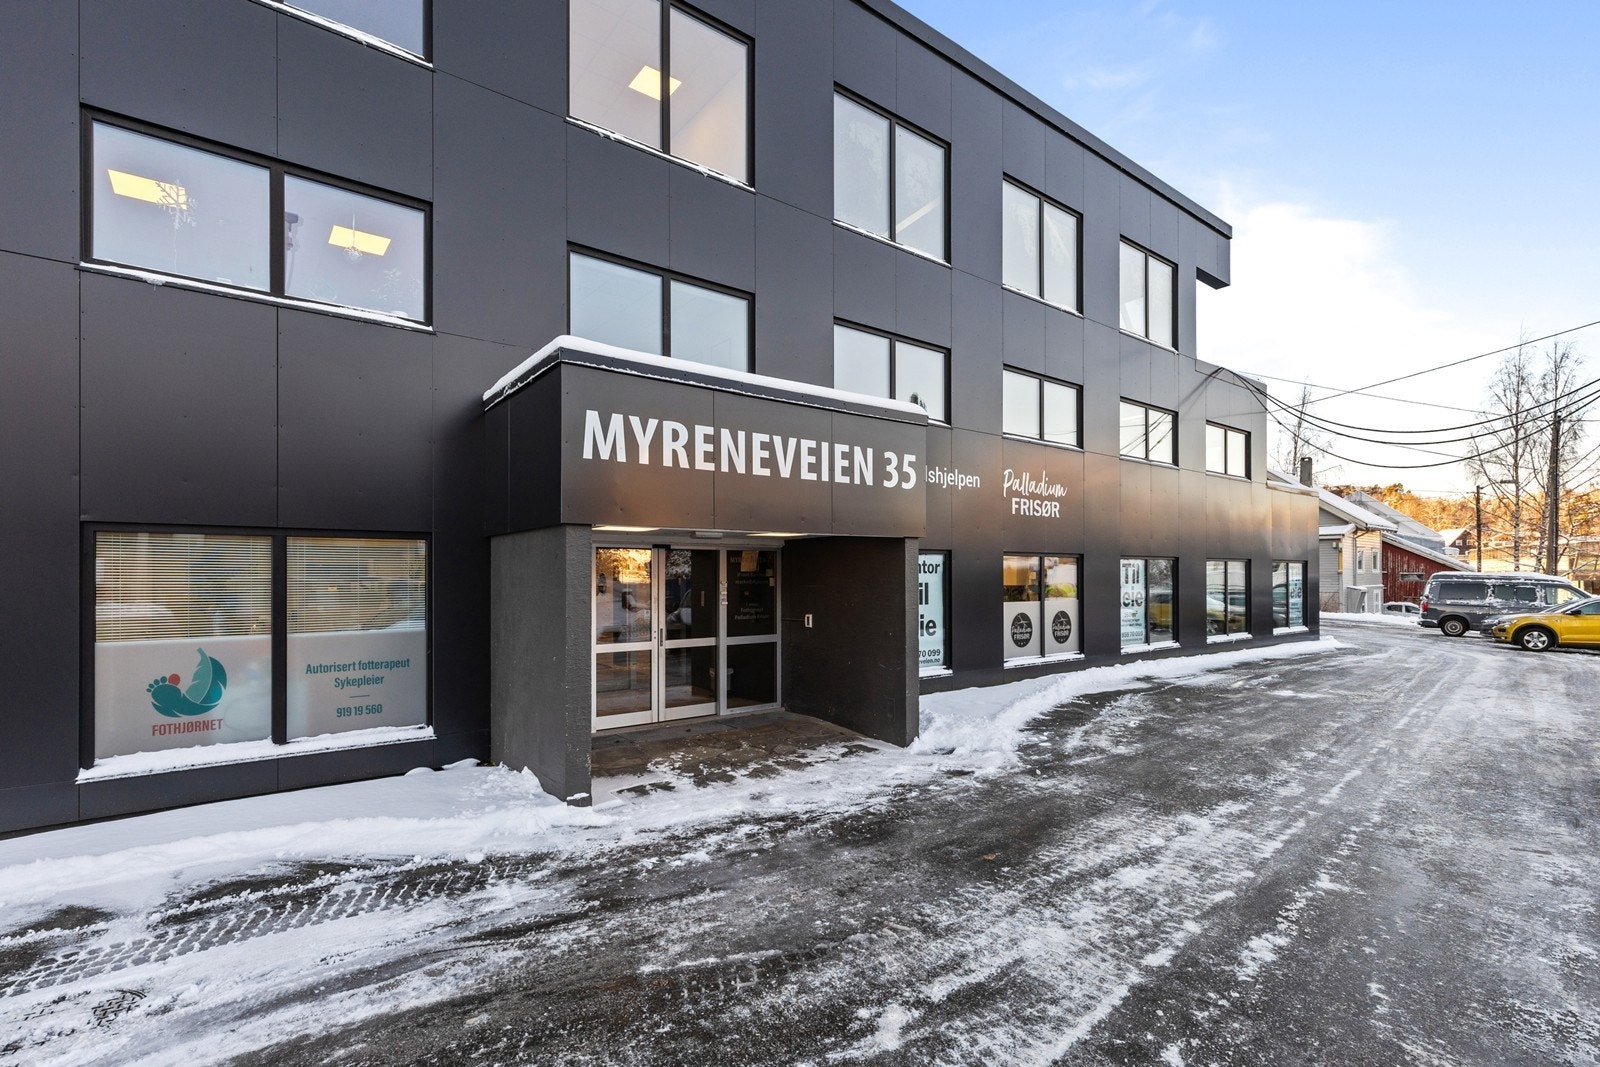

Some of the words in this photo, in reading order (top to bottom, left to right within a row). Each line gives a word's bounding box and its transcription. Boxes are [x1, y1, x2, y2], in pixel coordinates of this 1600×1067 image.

[582, 409, 874, 486] MYRENEVEIEN
[883, 451, 917, 490] 35
[1003, 469, 1068, 497] Palladium
[1012, 497, 1060, 518] FRISØR
[1122, 563, 1140, 584] Til
[927, 648, 941, 657] 099
[306, 661, 356, 675] Autorisert
[358, 658, 411, 671] fotterapeut
[334, 674, 385, 690] Sykepleier
[336, 707, 352, 718] 919
[353, 705, 364, 716] 19
[365, 703, 383, 715] 560
[152, 718, 224, 737] FOTHJØRNET
